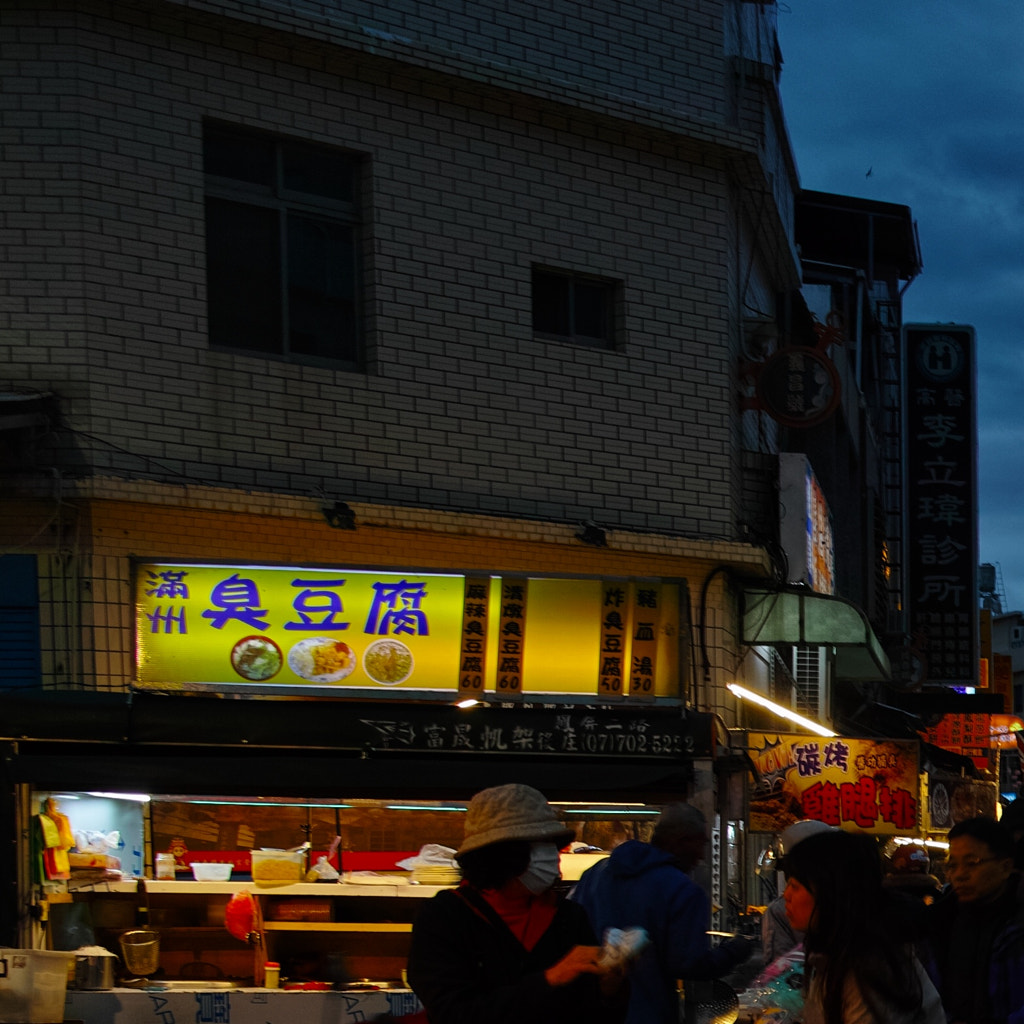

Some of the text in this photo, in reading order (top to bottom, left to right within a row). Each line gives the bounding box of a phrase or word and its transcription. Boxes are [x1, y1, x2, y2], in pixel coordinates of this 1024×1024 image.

[145, 570, 189, 634] 滿州
[201, 573, 429, 636] 臭豆腐
